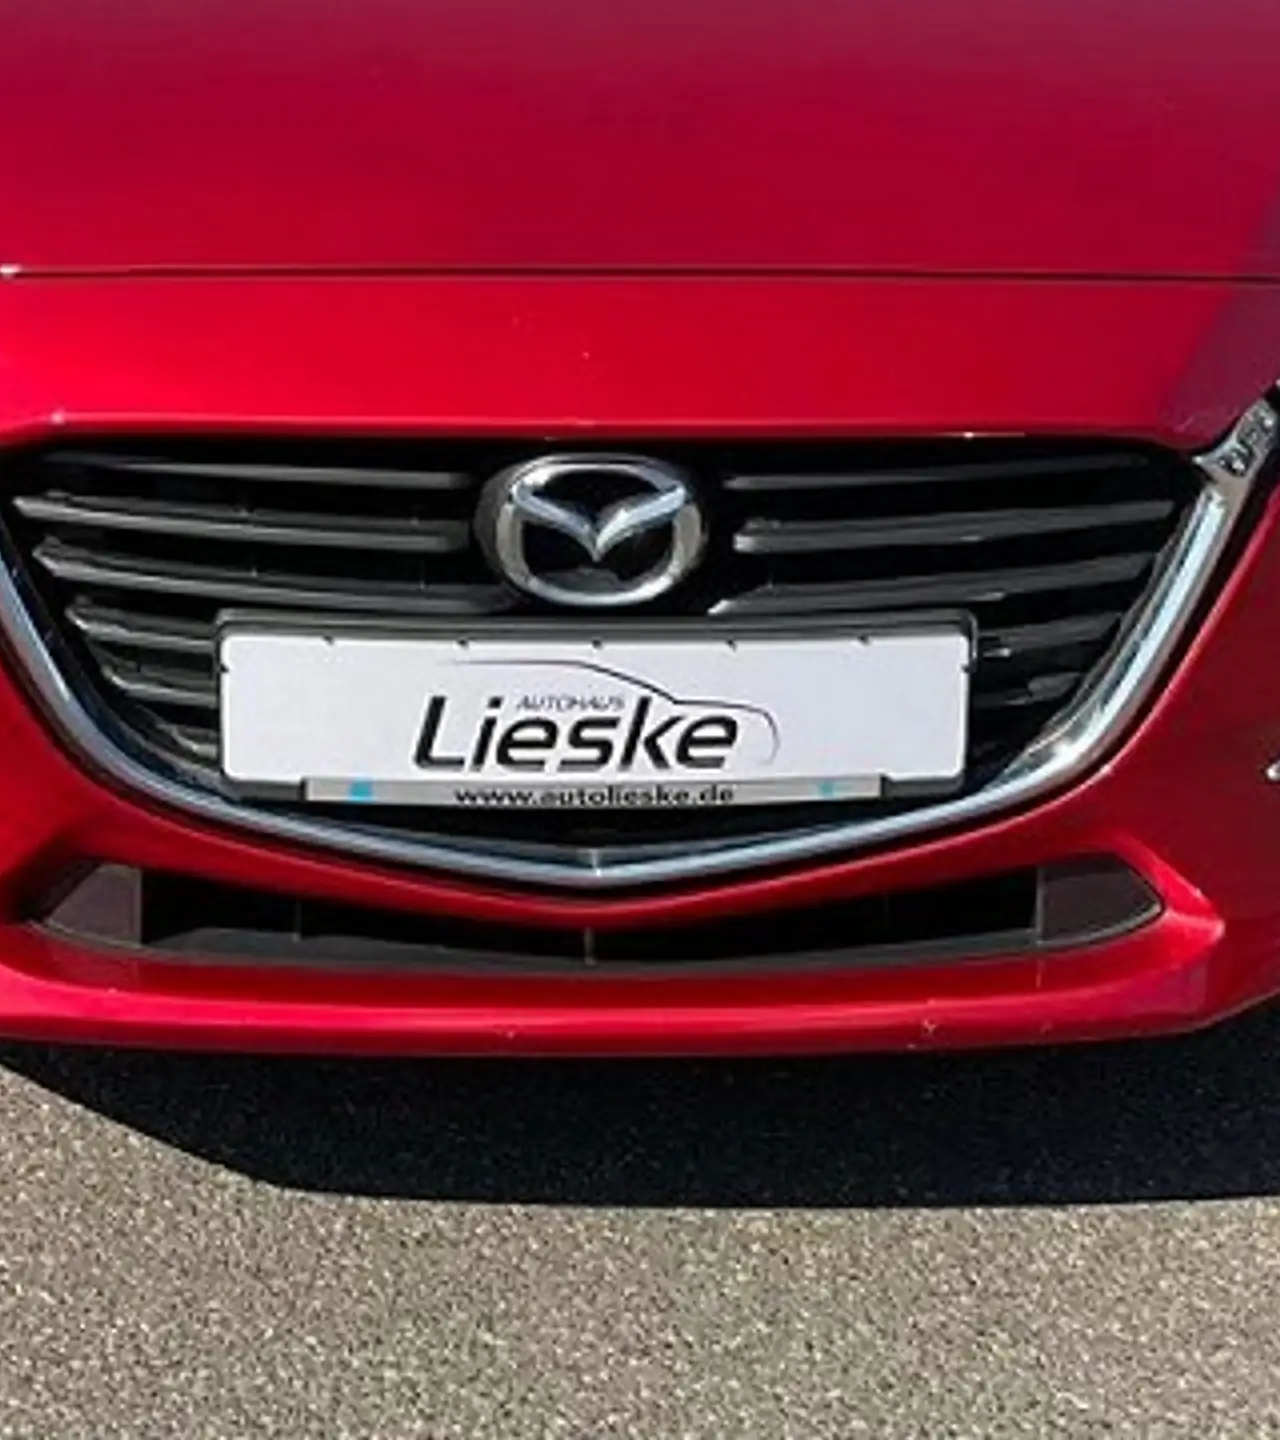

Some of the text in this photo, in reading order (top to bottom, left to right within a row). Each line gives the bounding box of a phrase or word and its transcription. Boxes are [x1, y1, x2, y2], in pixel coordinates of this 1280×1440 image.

[516, 694, 626, 711] AUTOHAUS
[413, 695, 739, 772] Lieske
[454, 785, 735, 806] www.autolieske.de
